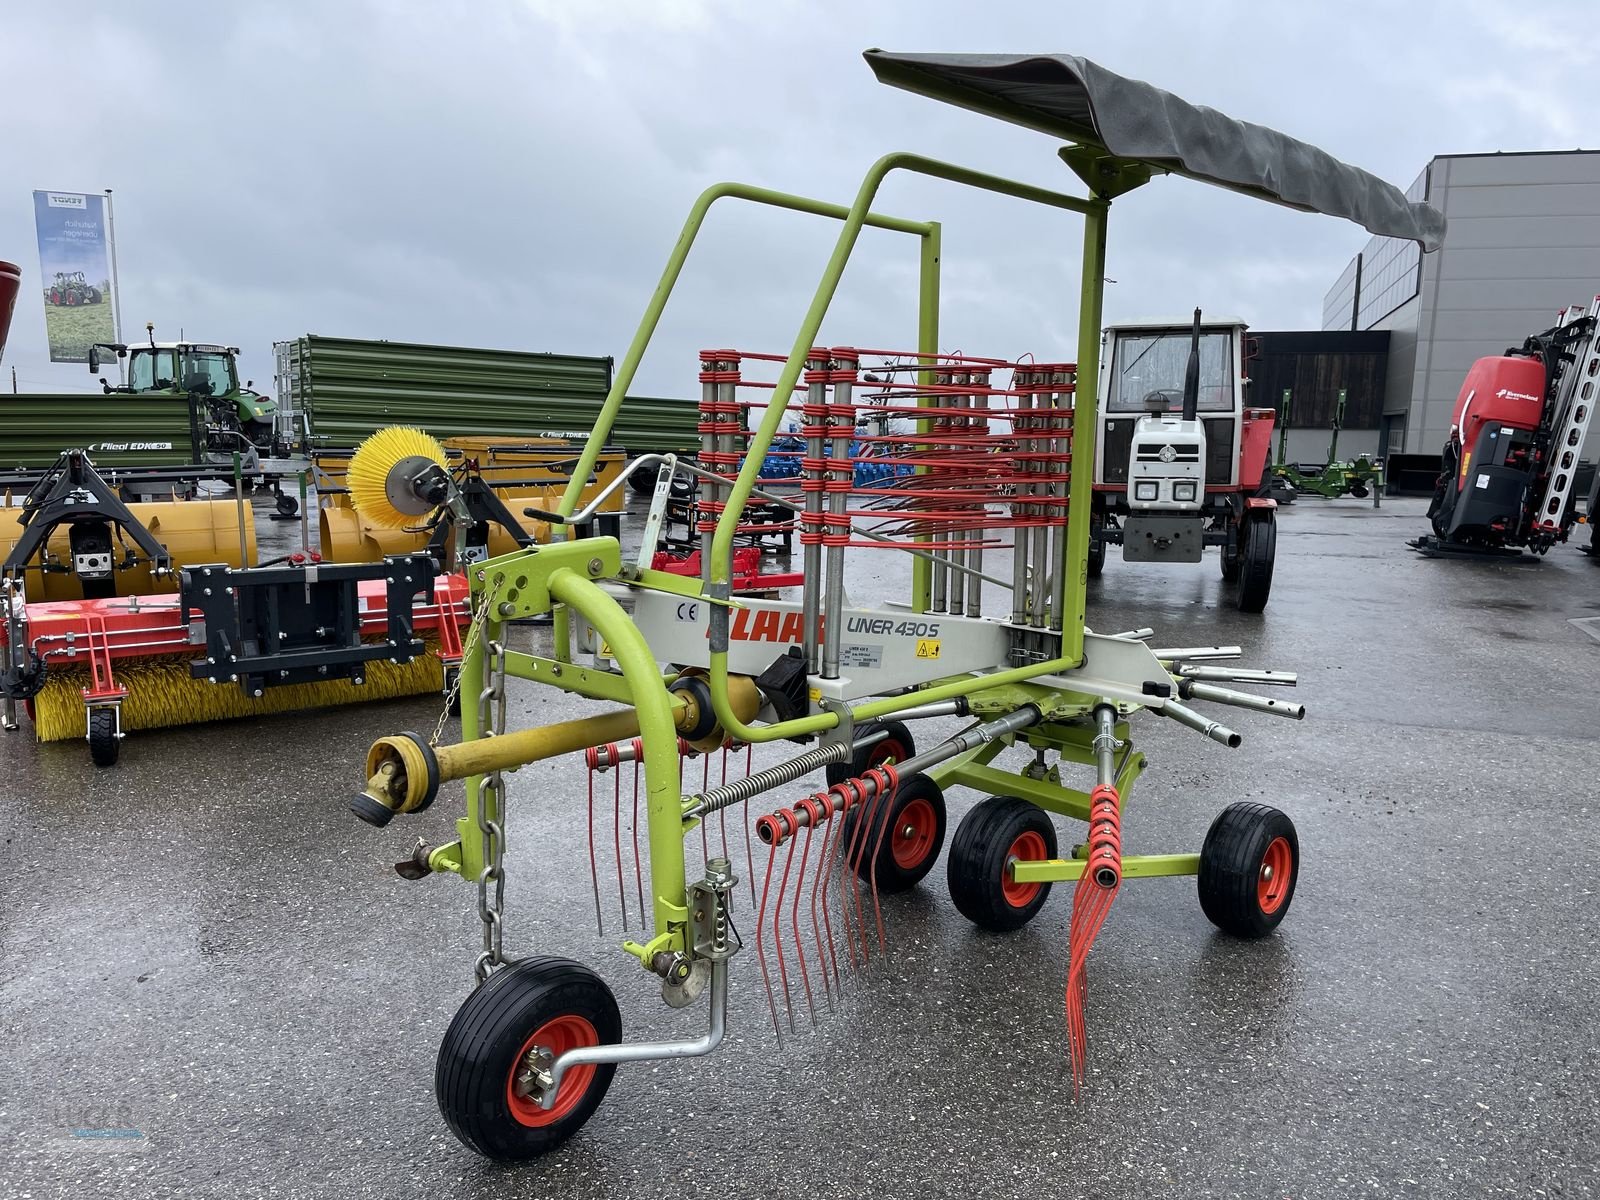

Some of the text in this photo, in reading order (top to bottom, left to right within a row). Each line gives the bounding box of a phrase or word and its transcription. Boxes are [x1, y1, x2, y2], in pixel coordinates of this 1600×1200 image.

[705, 607, 826, 645] LAA
[847, 617, 940, 638] LINER 430 S
